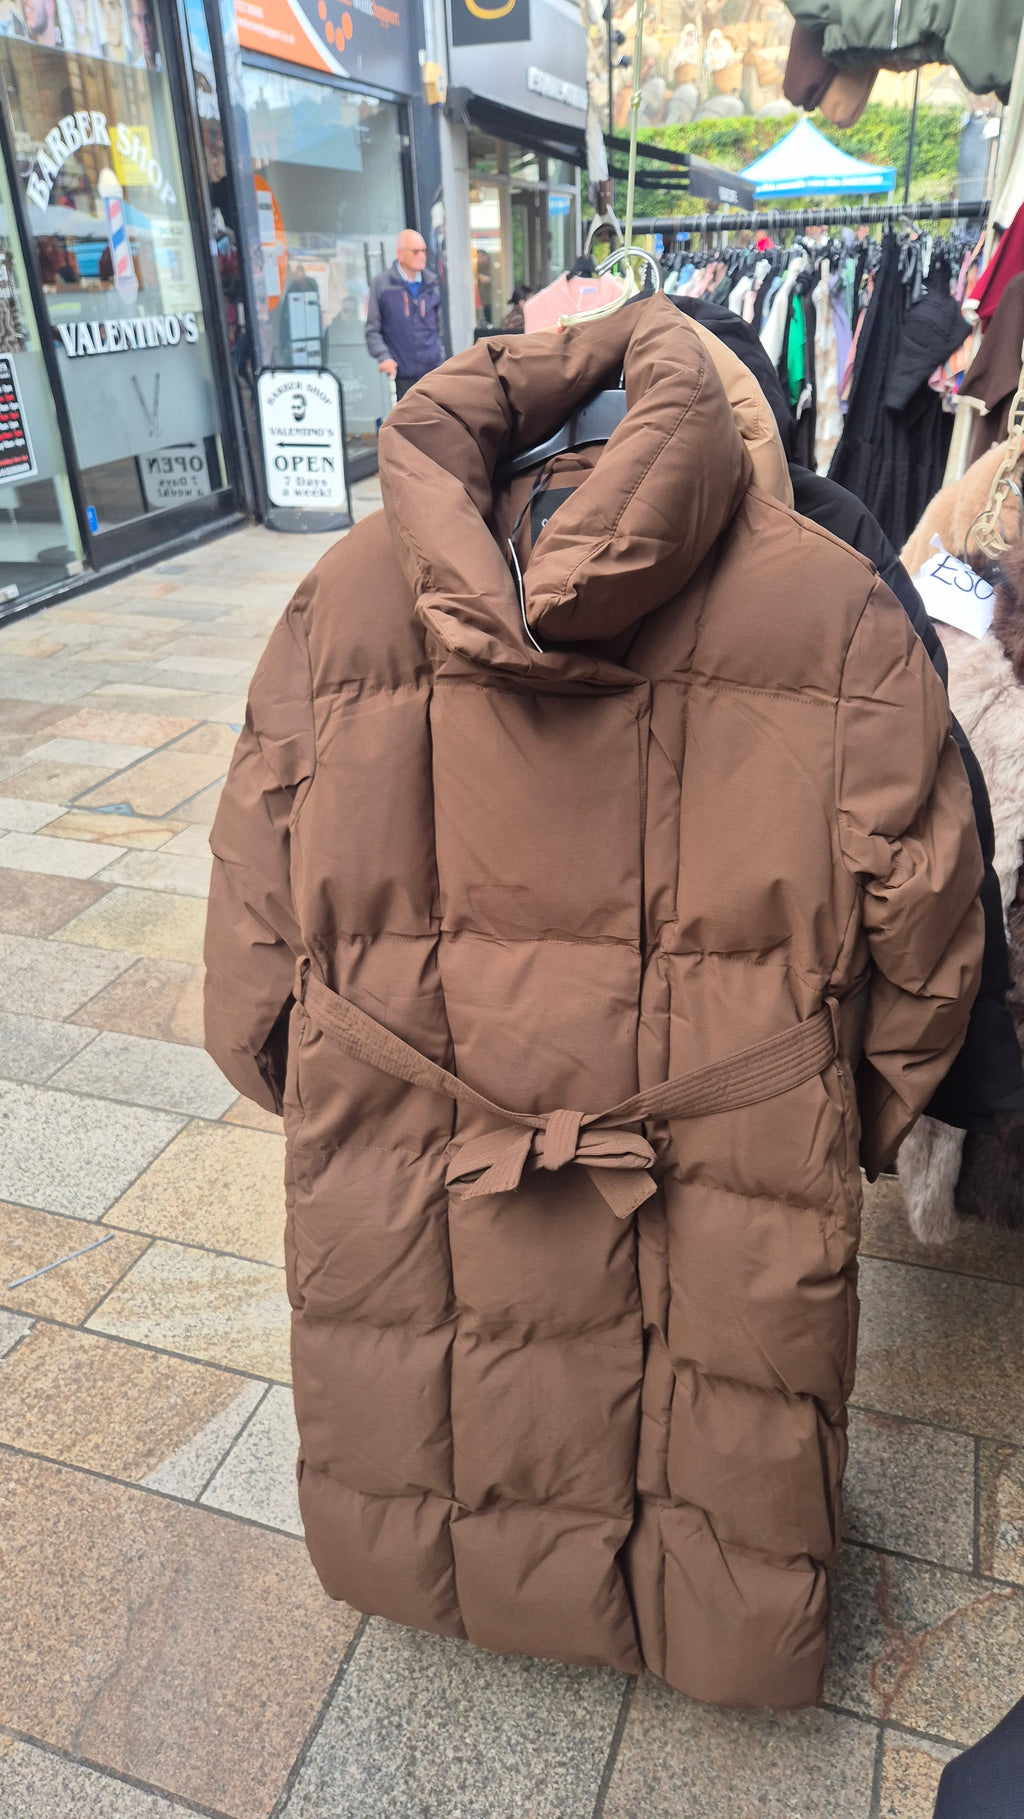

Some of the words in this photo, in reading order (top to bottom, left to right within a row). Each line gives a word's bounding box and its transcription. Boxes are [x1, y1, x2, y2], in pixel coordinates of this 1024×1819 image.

[26, 110, 112, 213] BARBER
[116, 122, 177, 205] SHOP
[57, 311, 199, 357] VALENTINO'S
[306, 384, 333, 405] SHOP
[269, 426, 335, 438] VALENTINO'S
[274, 454, 335, 473] OPEN
[296, 476, 328, 488] Days
